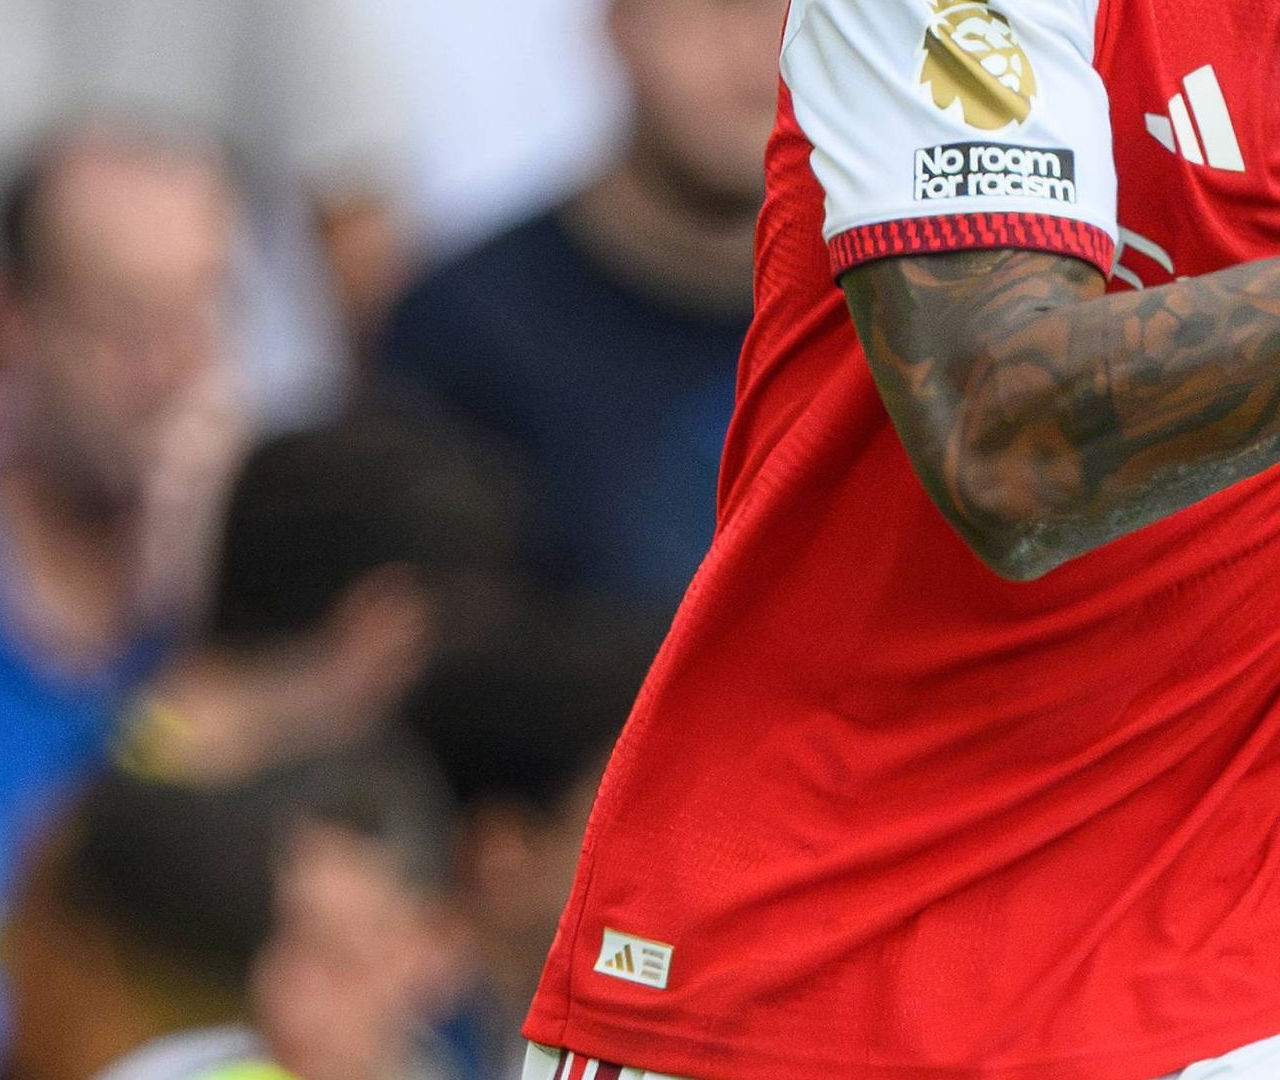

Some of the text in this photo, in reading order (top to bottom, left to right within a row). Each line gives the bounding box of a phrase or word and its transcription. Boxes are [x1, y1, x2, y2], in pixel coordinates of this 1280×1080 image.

[915, 146, 1061, 177] No room
[914, 172, 1077, 203] for racism
